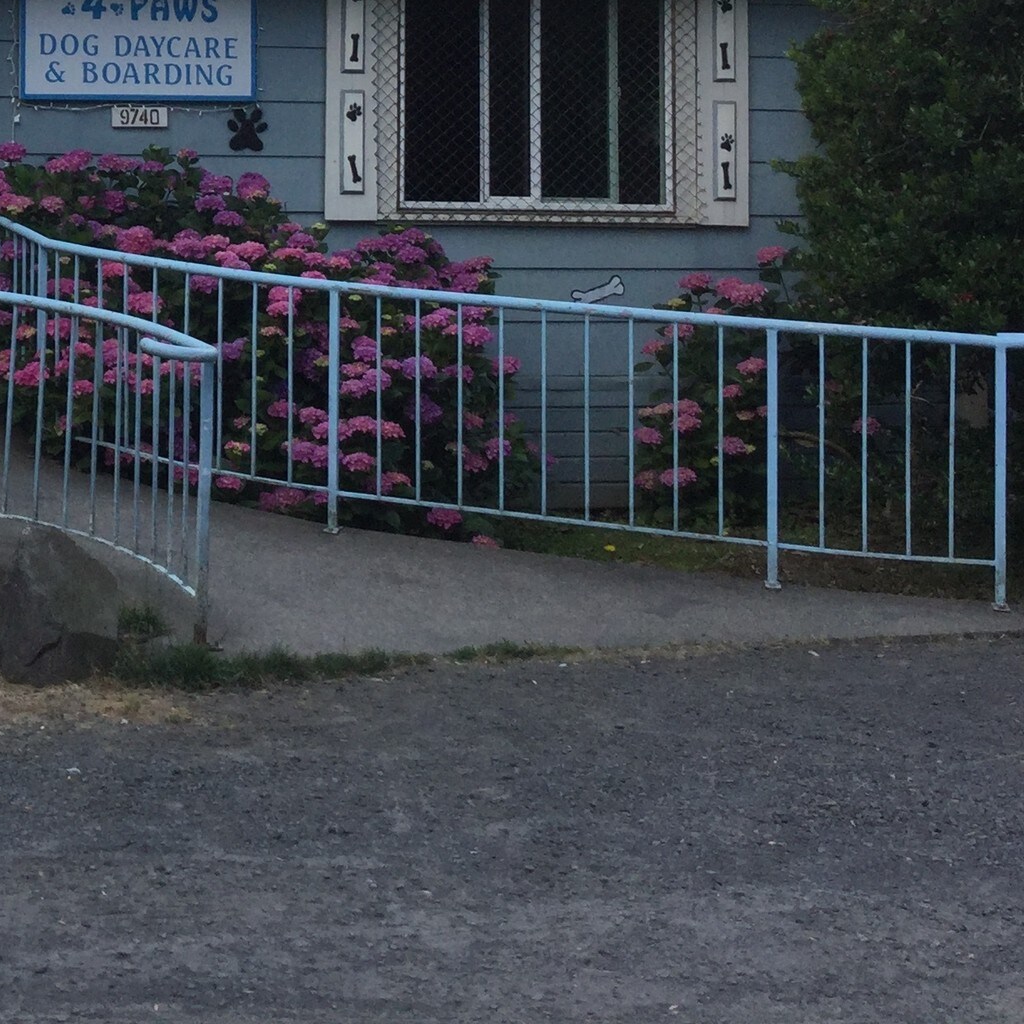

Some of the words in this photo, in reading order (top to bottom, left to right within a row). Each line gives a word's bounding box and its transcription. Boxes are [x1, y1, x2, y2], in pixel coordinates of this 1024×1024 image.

[39, 33, 99, 56] DOG
[113, 34, 239, 59] DAYCARE
[44, 61, 66, 83] &
[82, 61, 234, 86] BOARDING
[119, 108, 160, 126] 9740
